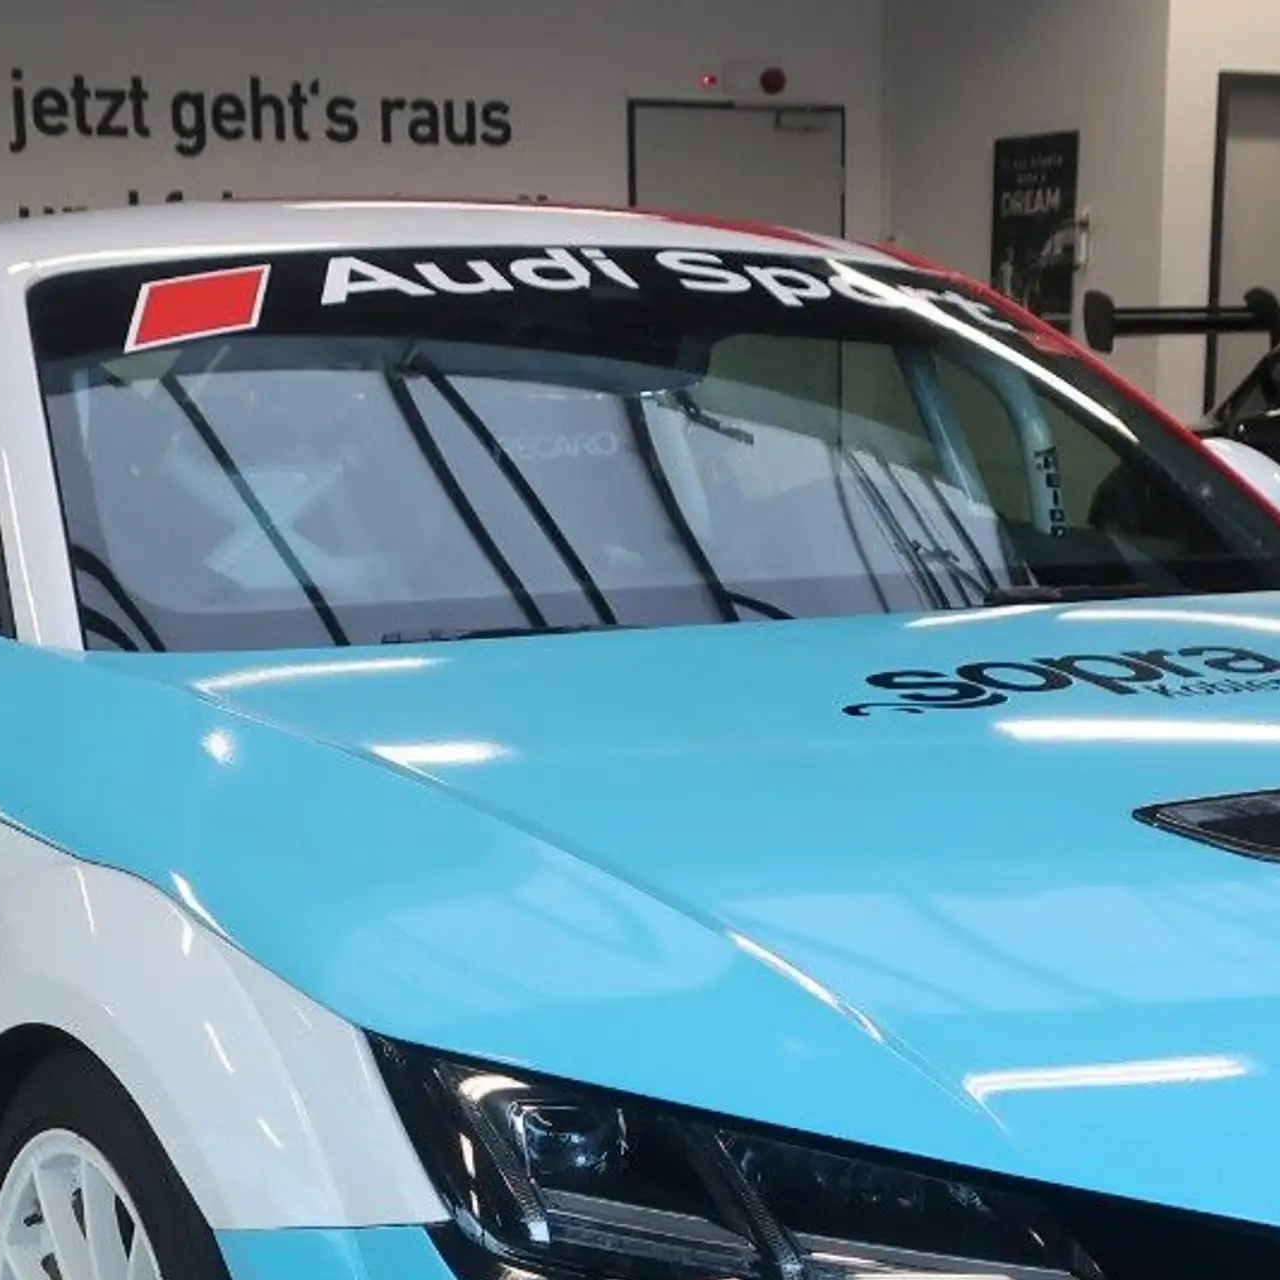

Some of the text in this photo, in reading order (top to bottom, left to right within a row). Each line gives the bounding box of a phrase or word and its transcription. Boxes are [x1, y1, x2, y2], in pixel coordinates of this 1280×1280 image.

[9, 68, 150, 153] jetzt
[380, 97, 513, 146] raus
[320, 246, 1019, 332] Audi Sport
